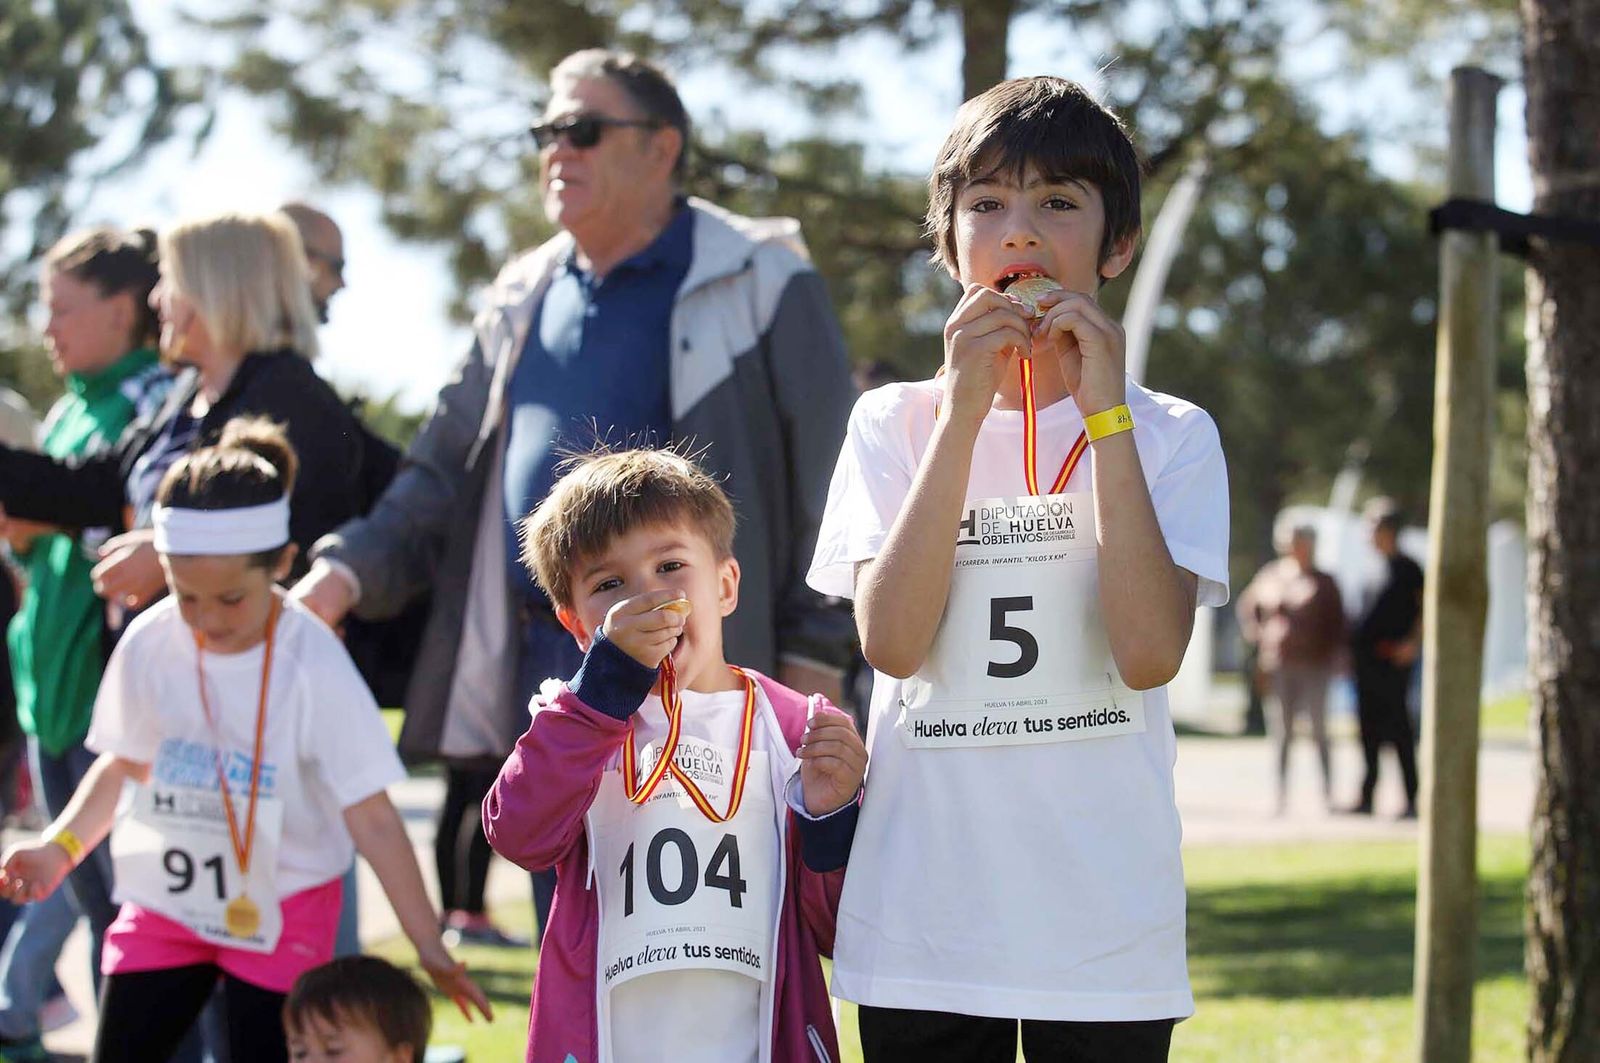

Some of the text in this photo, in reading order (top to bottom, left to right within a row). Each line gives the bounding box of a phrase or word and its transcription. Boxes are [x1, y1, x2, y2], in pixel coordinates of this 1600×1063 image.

[981, 498, 1074, 520] DIPUTACIÓN
[981, 517, 1074, 535] DE HUELVA
[982, 532, 1043, 545] OBJETIVOS
[962, 559, 989, 567] CARRERA
[992, 557, 1024, 565] INFANTIL
[986, 595, 1040, 679] 5
[914, 708, 1131, 737] Huelva eleva tus sentidos.
[642, 744, 724, 763] DIPTACIÓN
[163, 848, 226, 900] 91
[619, 827, 747, 918] 104
[604, 943, 761, 984] Huelva eleva tus sentidos.
